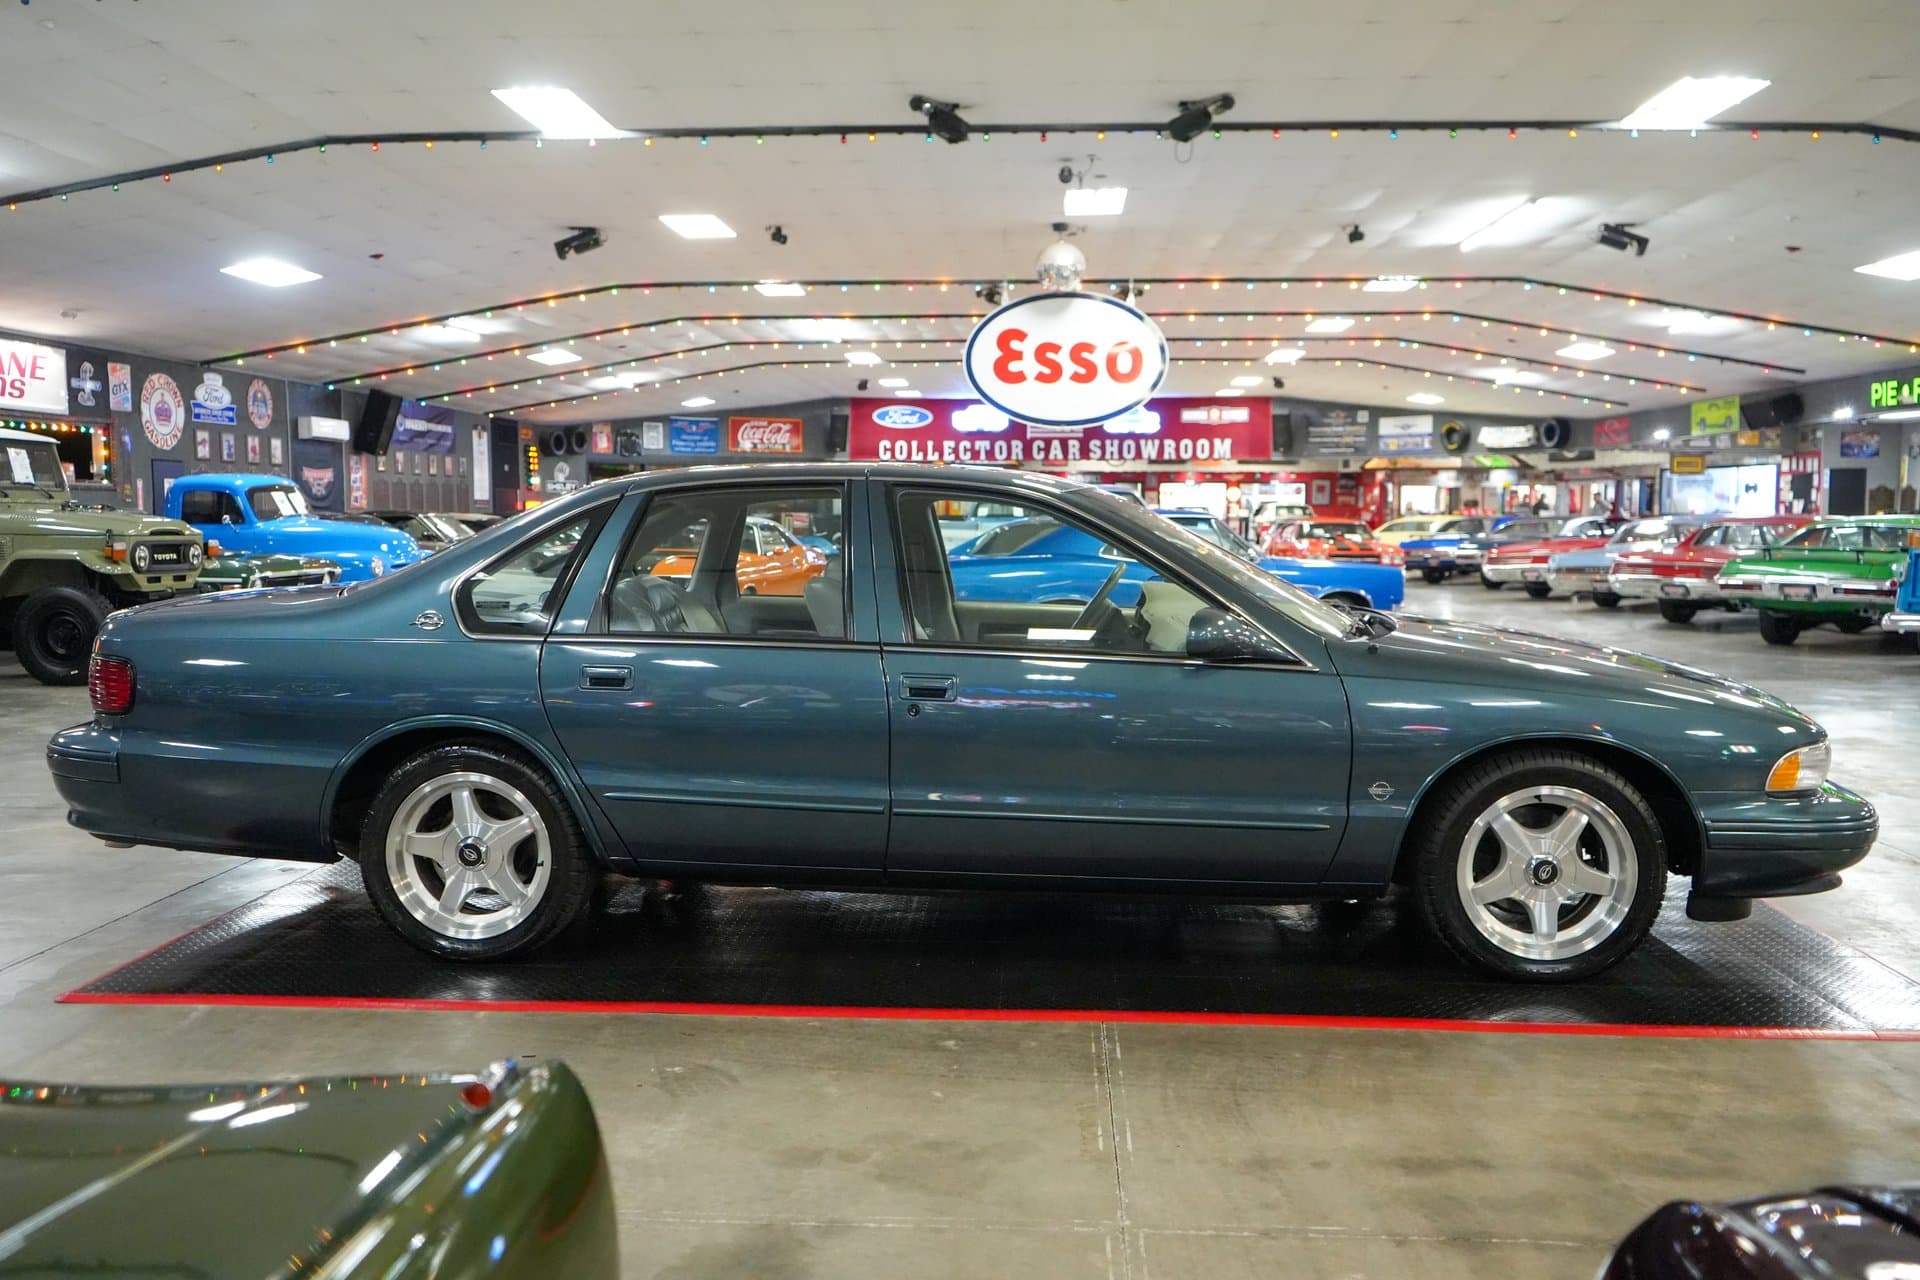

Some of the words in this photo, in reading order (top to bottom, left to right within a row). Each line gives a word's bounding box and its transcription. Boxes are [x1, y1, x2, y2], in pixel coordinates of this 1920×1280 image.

[993, 328, 1143, 384] Esso
[143, 378, 155, 404] RED
[158, 374, 182, 408] CROWN
[203, 386, 224, 403] Ford
[1871, 380, 1898, 408] PIE
[884, 408, 921, 424] Ford
[878, 439, 1024, 461] COLLECTOR
[1032, 439, 1081, 461] CAR
[1089, 438, 1233, 461] SHOWROOM
[153, 553, 177, 561] TOYOTA
